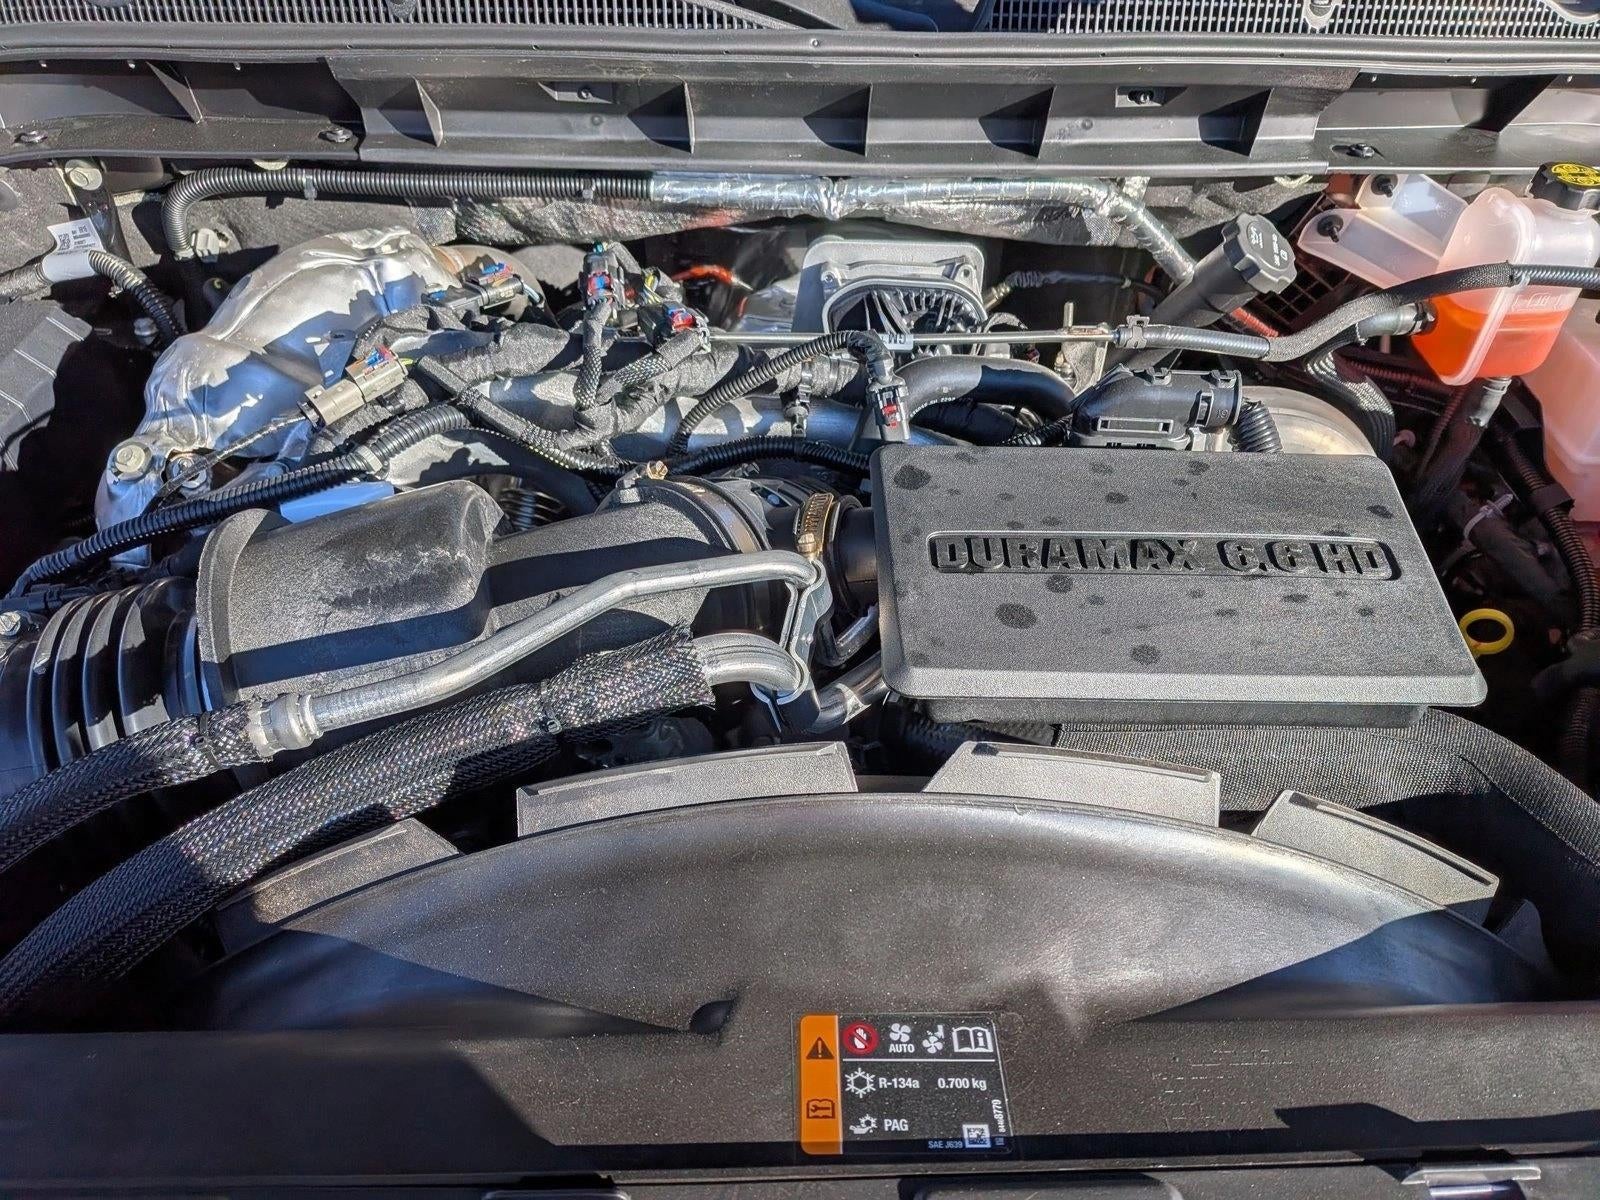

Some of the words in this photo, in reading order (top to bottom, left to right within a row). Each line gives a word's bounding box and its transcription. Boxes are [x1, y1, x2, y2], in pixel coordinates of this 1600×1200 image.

[932, 537, 1204, 571] DURAMAX
[889, 1044, 915, 1053] AUTO
[878, 1077, 920, 1089] R-134a
[937, 1077, 970, 1089] 0.700
[972, 1077, 987, 1091] kg
[883, 1118, 909, 1131] PAG
[928, 1140, 944, 1149] SAE
[945, 1140, 963, 1149] J639
